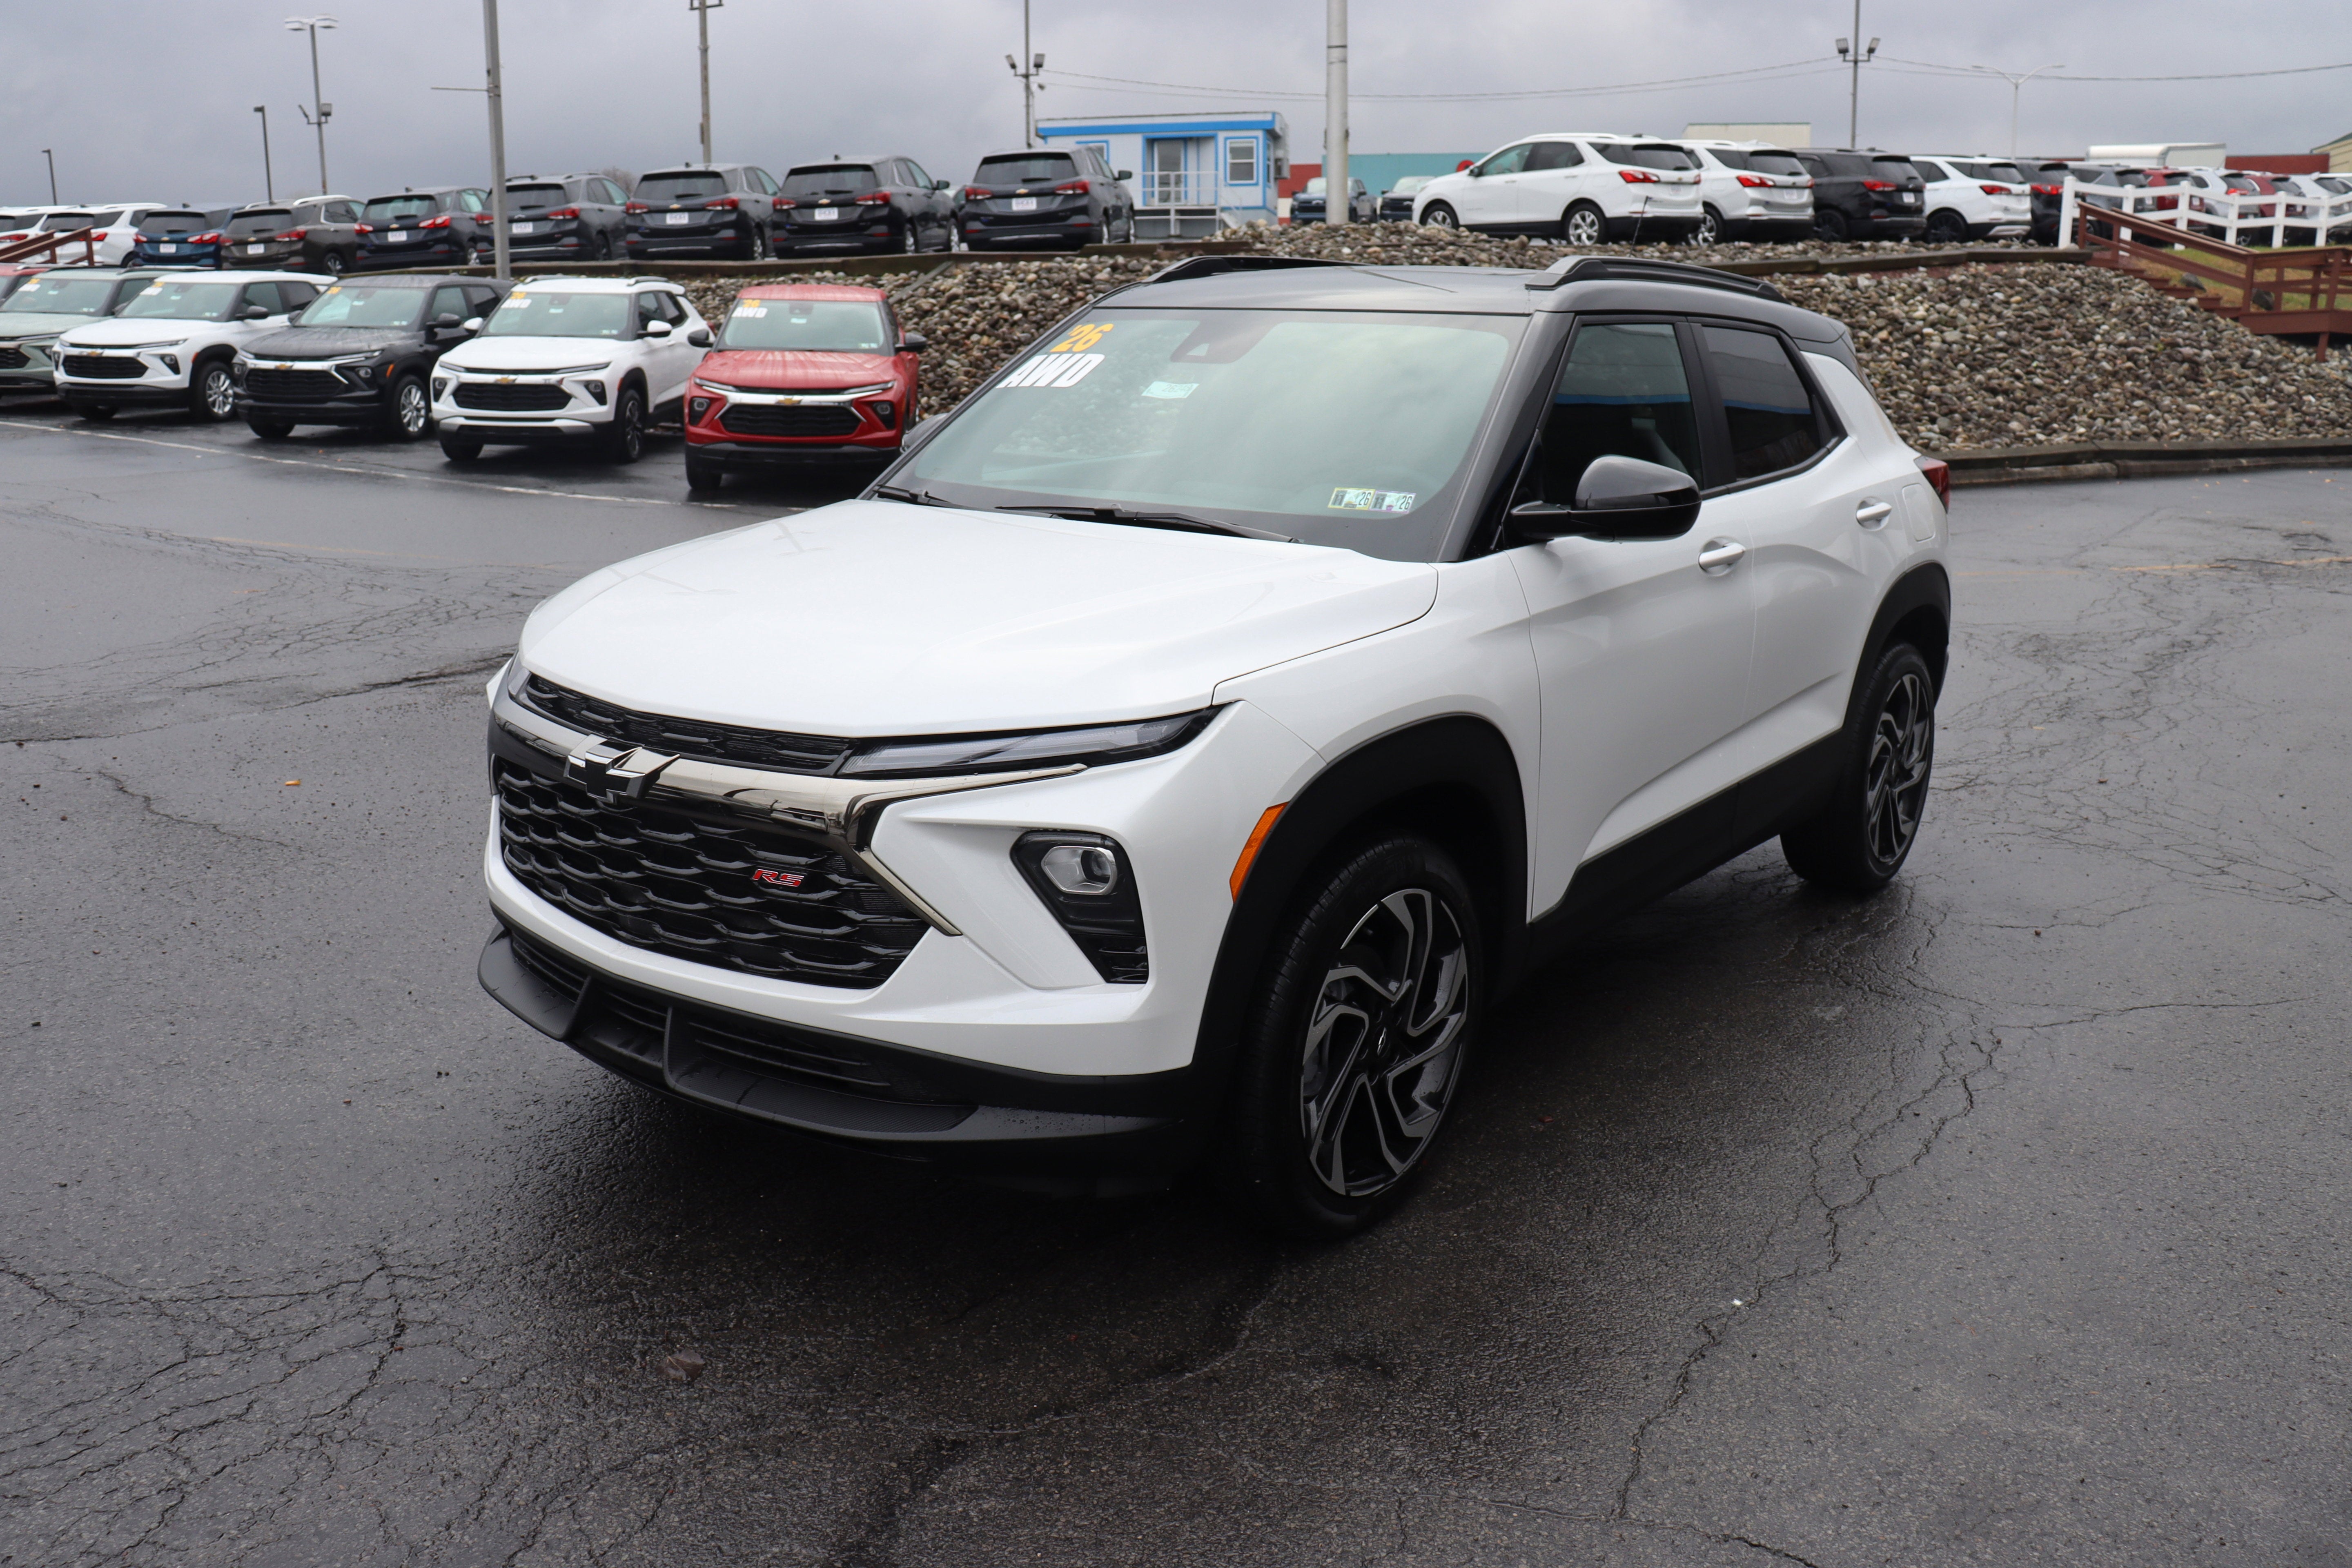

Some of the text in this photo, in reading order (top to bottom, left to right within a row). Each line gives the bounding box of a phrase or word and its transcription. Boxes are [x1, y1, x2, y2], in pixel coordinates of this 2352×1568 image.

[732, 306, 768, 318] AWD
[996, 353, 1105, 388] AWD
[1358, 492, 1371, 506] 26
[1399, 495, 1412, 510] 26
[752, 868, 804, 887] RS
